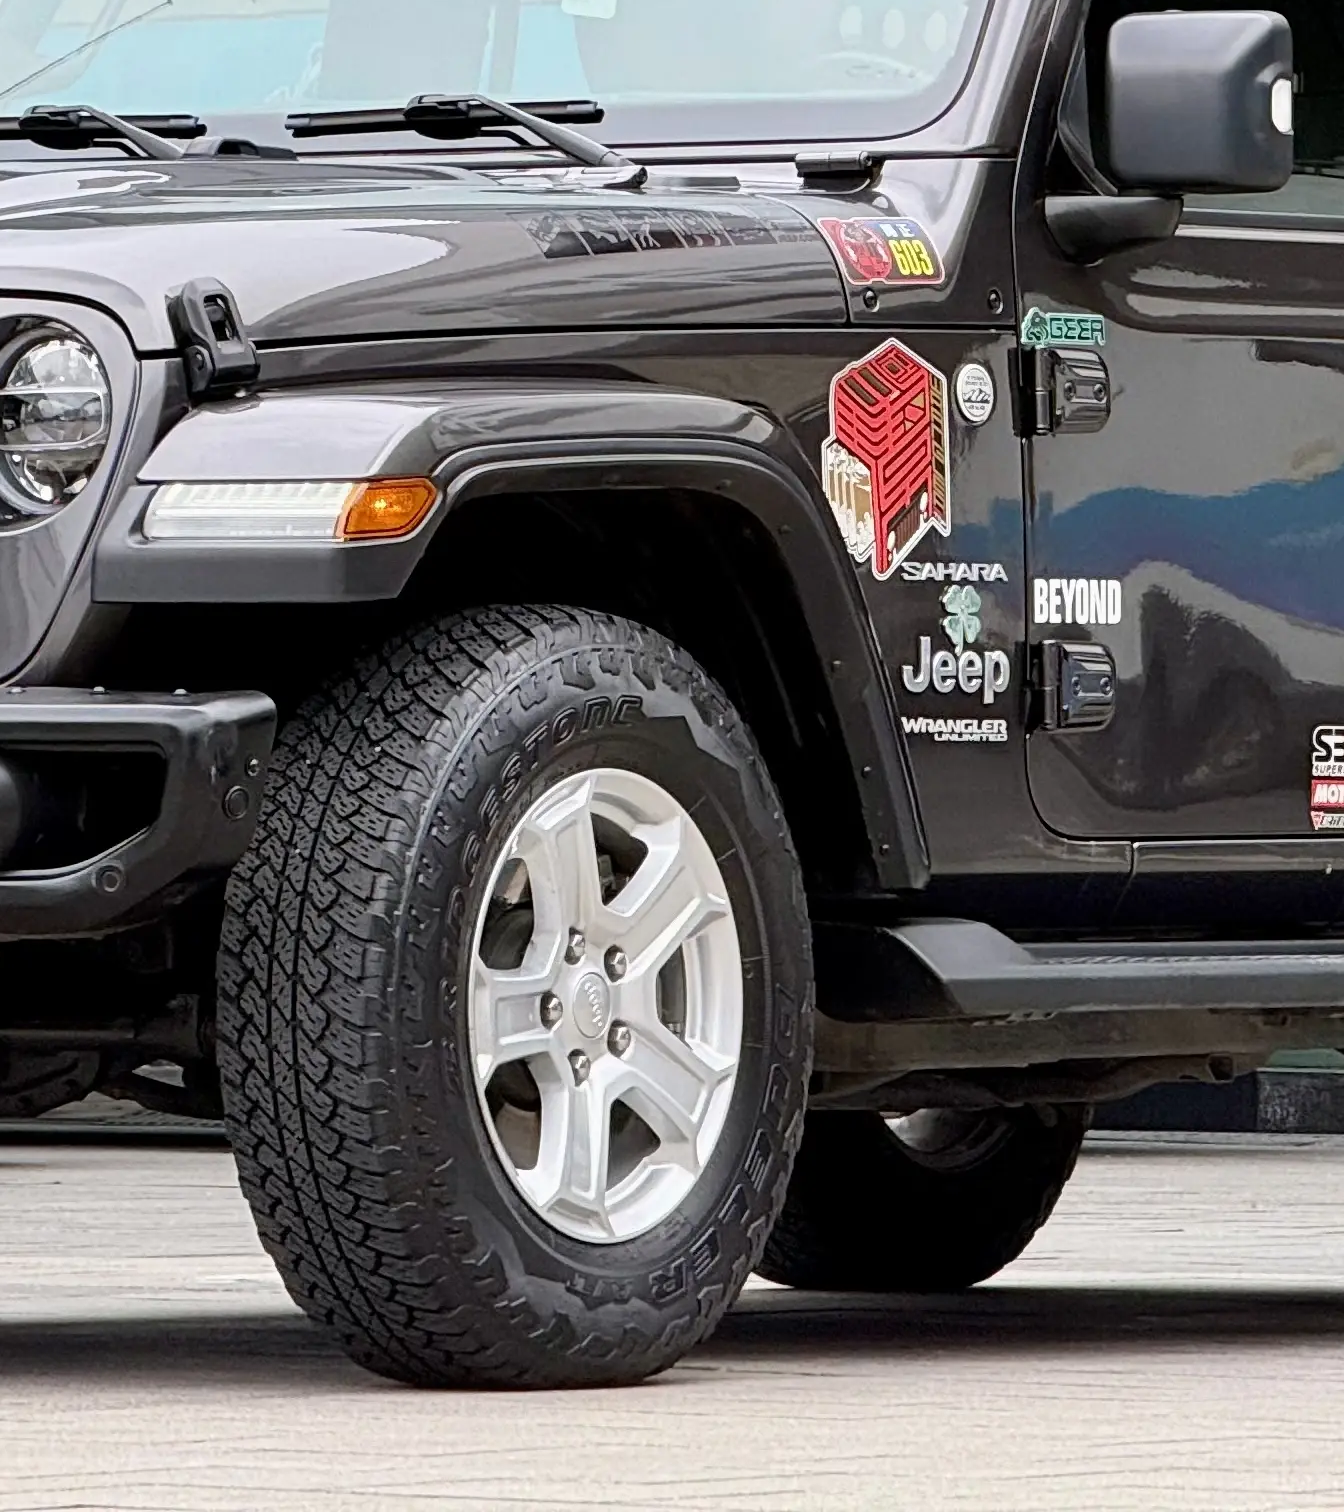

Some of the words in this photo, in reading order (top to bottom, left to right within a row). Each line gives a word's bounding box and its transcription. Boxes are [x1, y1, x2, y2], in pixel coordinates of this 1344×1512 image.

[888, 239, 934, 276] 603
[901, 561, 1009, 582] SAHARA
[1033, 578, 1122, 625] BEYOND
[901, 635, 1011, 705] Jeep
[900, 717, 1007, 734] WRANGLER
[934, 732, 1008, 742] UNLIMITED
